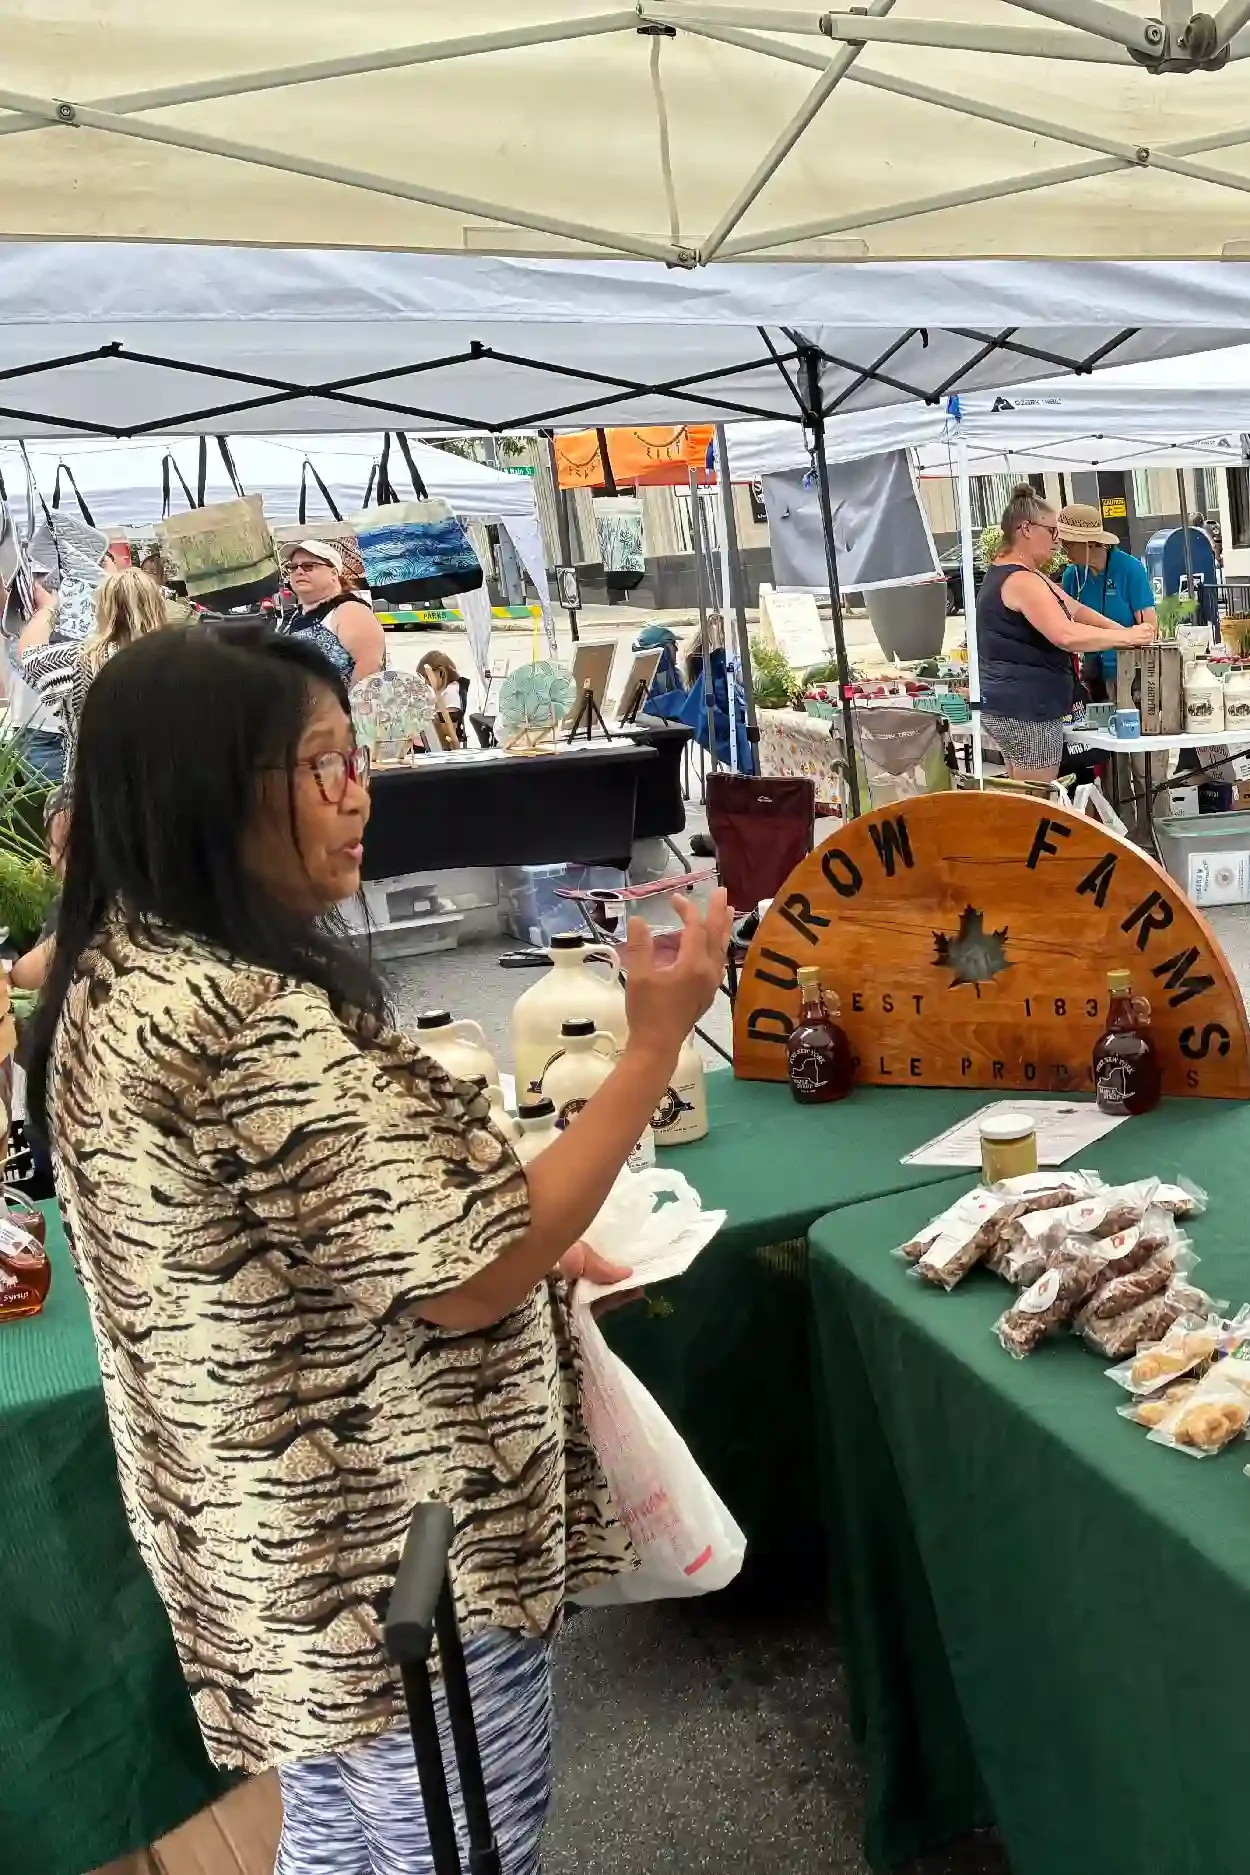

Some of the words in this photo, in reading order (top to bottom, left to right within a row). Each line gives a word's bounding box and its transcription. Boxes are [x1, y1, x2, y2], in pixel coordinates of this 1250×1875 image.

[746, 815, 915, 1045] DUROW
[1025, 817, 1231, 1060] FARMS
[852, 996, 924, 1016] EST
[1023, 997, 1098, 1018] 183
[851, 1056, 922, 1077] PLE
